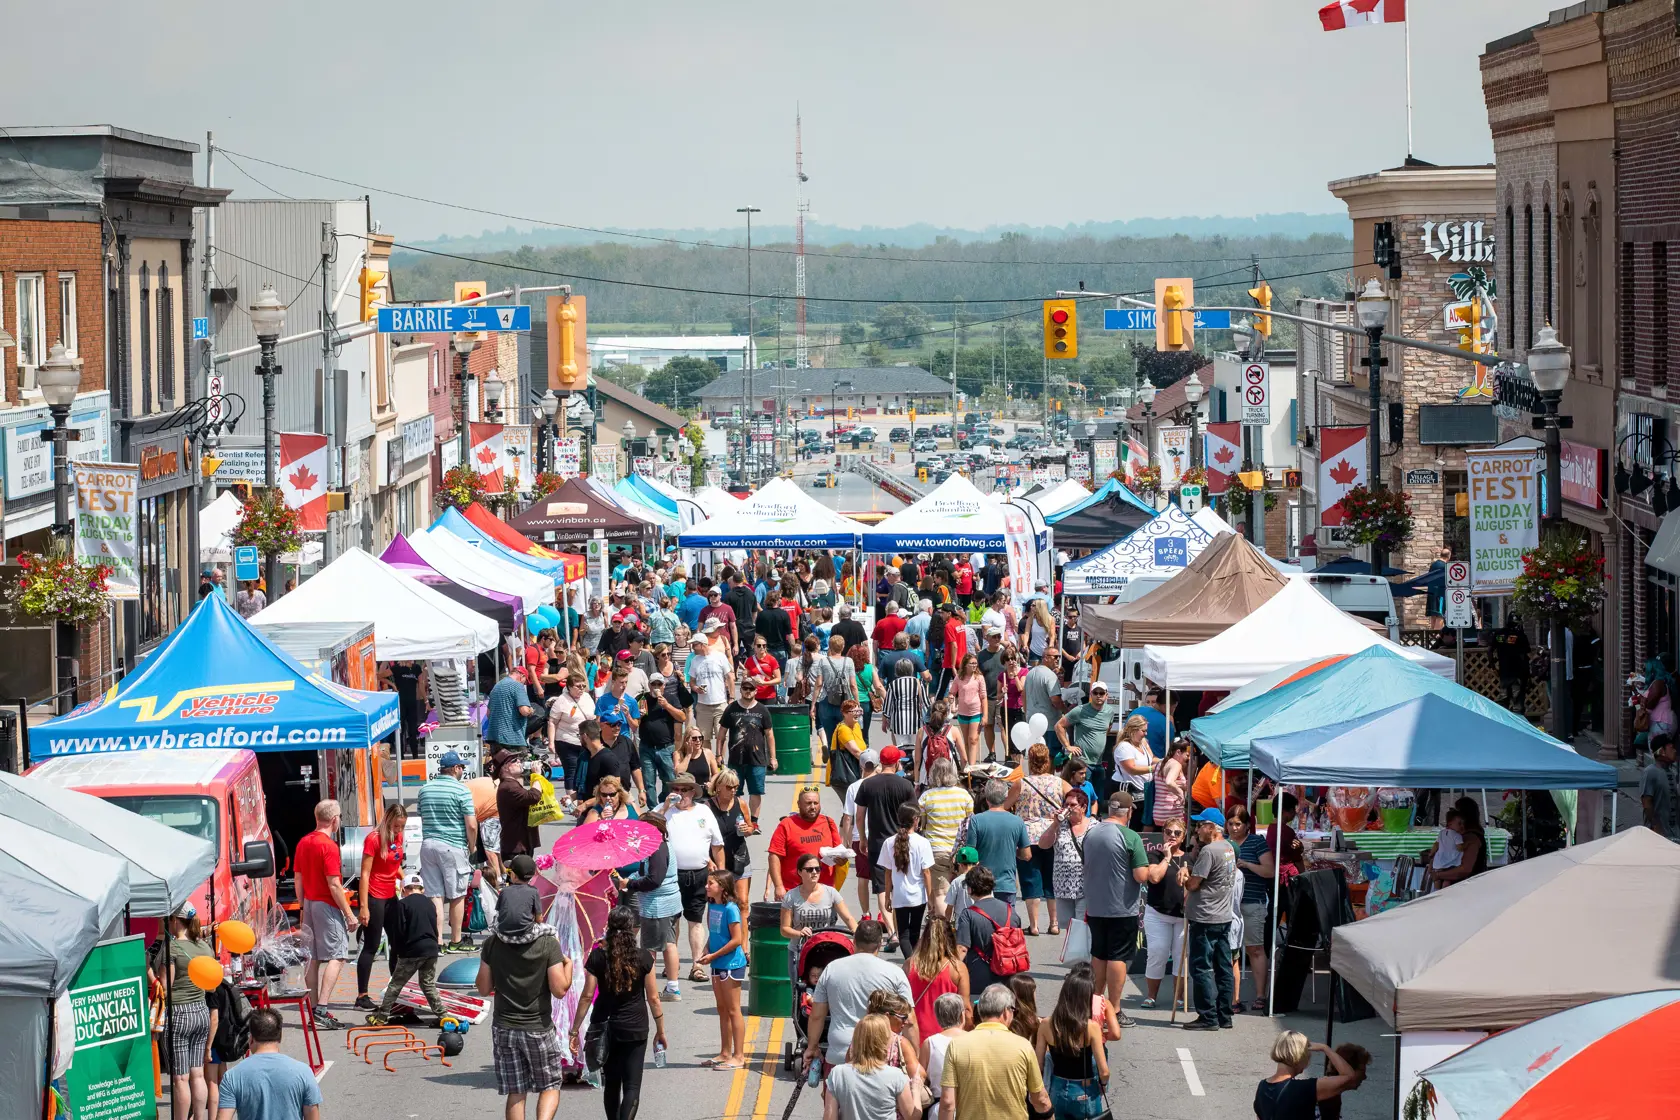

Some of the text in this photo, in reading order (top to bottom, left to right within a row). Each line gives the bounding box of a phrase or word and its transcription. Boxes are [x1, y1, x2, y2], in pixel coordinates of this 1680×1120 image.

[392, 309, 478, 331] BARRIE ST
[502, 314, 509, 323] 4
[503, 435, 528, 445] FEST
[1163, 436, 1186, 447] FEST
[251, 459, 259, 467] in
[1471, 459, 1533, 475] CARROT
[229, 468, 244, 476] Day
[76, 472, 135, 488] CARROT
[1472, 475, 1533, 501] FEST
[77, 488, 134, 513] FEST
[1474, 503, 1532, 519] FRIDAY
[79, 513, 132, 531] FRIDAY
[527, 517, 606, 526] www.vinbon.ca
[1474, 518, 1534, 532] AUGUST 16
[79, 528, 133, 542] AUGUST 16
[1498, 533, 1509, 545] &
[100, 543, 110, 554] &
[1167, 538, 1174, 548] 3
[1157, 547, 1184, 555] SPEED
[77, 554, 134, 567] SATURDAY
[1475, 559, 1521, 572] AUGUST
[1085, 575, 1128, 584] AMSTERDAM
[1091, 583, 1123, 591] Brewery
[191, 692, 280, 710] Vehicle
[180, 704, 275, 719] Venture
[800, 834, 822, 844] PUMA
[87, 991, 113, 1005] FAMILY
[113, 986, 136, 999] NEEDS
[73, 997, 137, 1025] INANCIAL
[75, 1013, 138, 1042] DUCATION
[88, 1079, 114, 1091] Knowledge
[95, 1090, 106, 1099] WFG
[111, 1083, 136, 1095] determined
[85, 1101, 103, 1112] provide
[102, 1097, 119, 1109] people
[119, 1090, 145, 1102] throughout
[80, 1112, 94, 1120] North
[94, 1108, 112, 1118] America
[112, 1105, 124, 1114] with
[127, 1099, 146, 1110] financial
